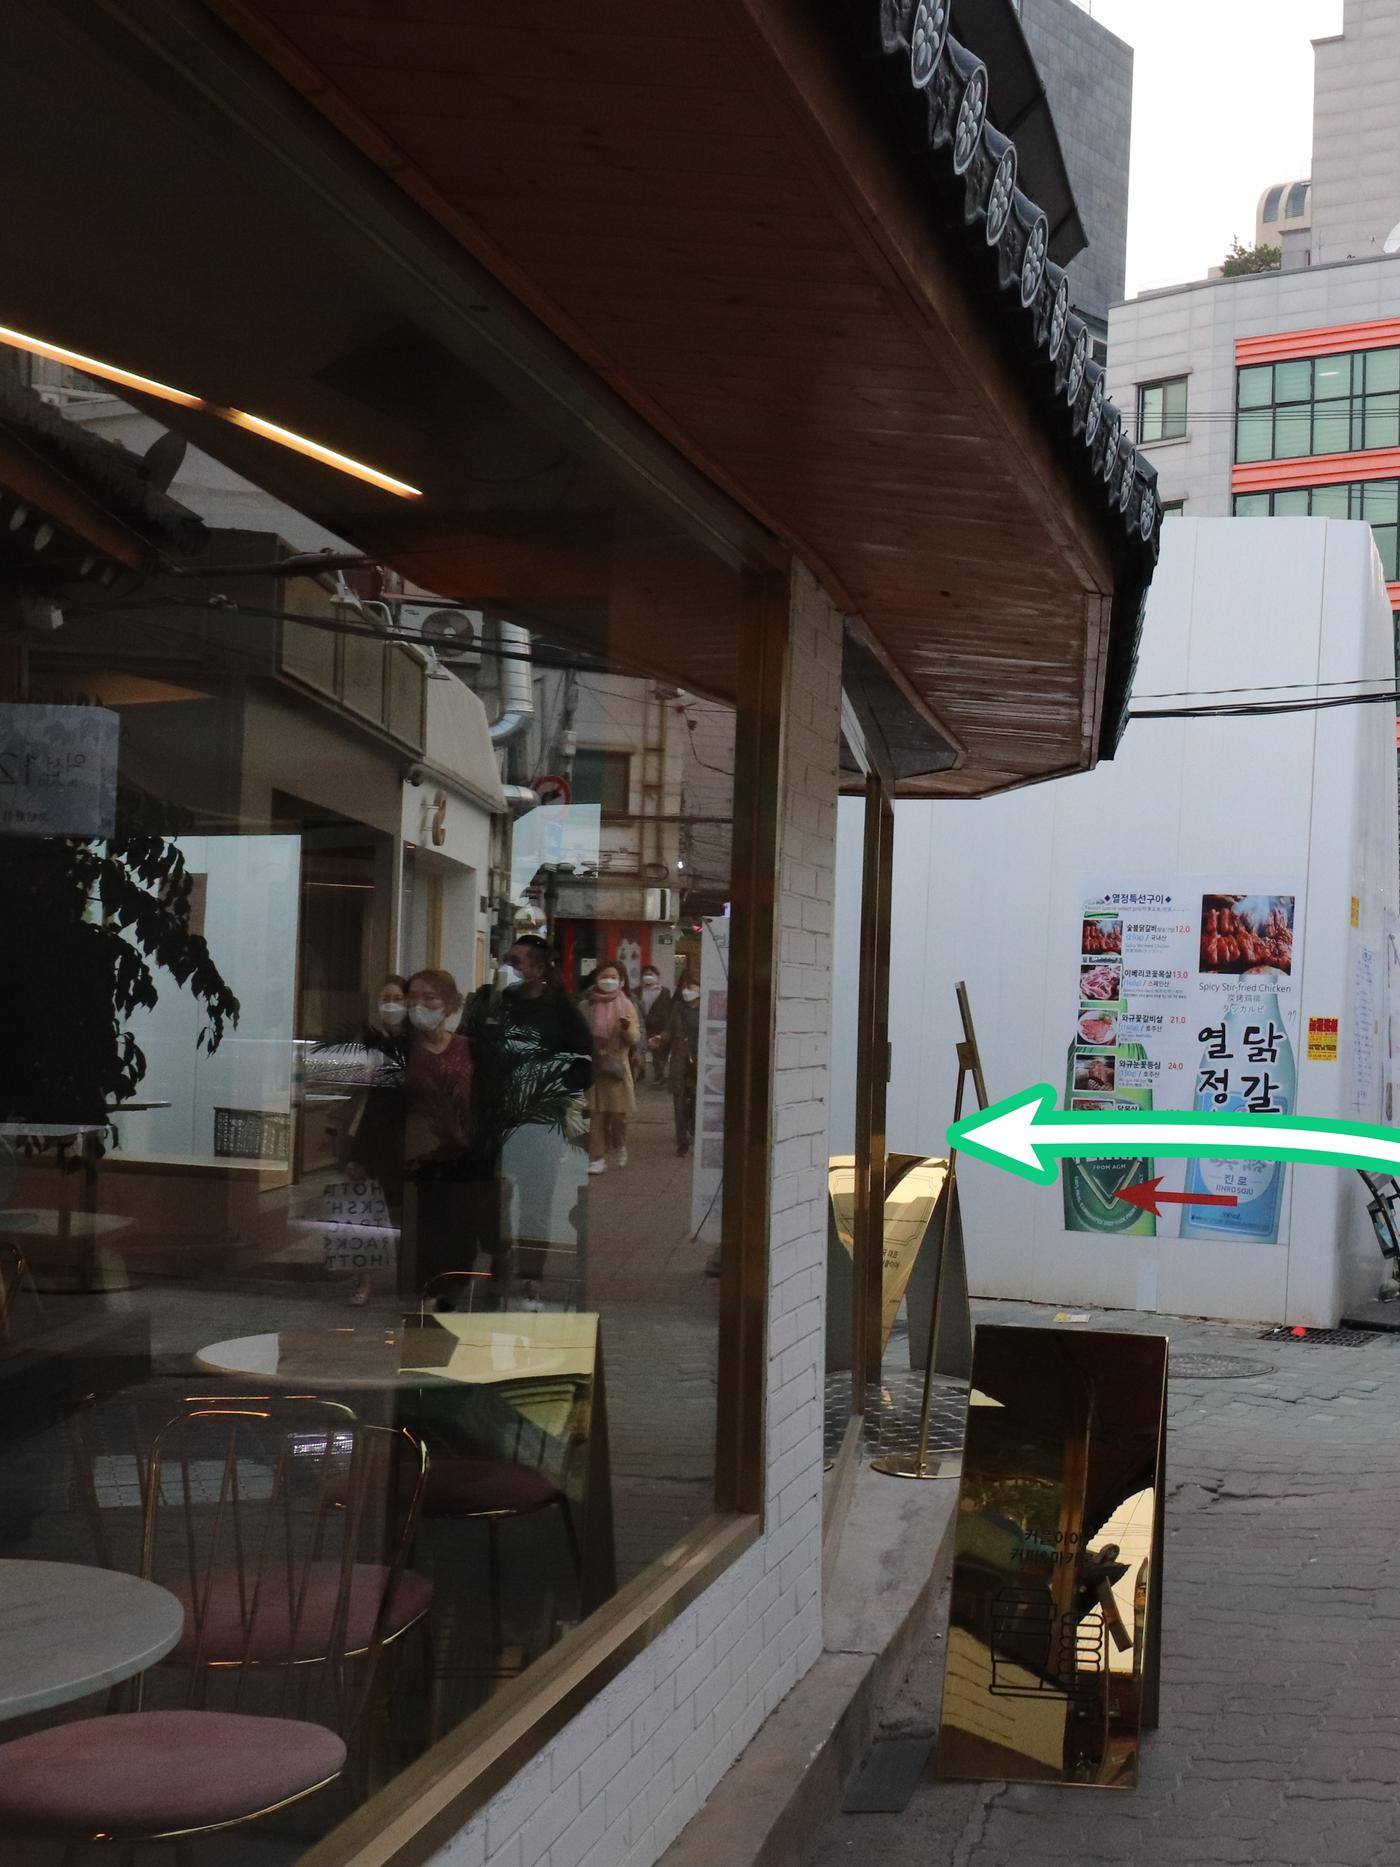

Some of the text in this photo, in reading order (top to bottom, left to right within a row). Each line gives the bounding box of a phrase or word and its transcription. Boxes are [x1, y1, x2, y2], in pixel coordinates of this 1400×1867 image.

[1111, 893, 1164, 905] 열정특선구이
[1199, 982, 1220, 994] Spicy
[1259, 984, 1292, 993] Chicken
